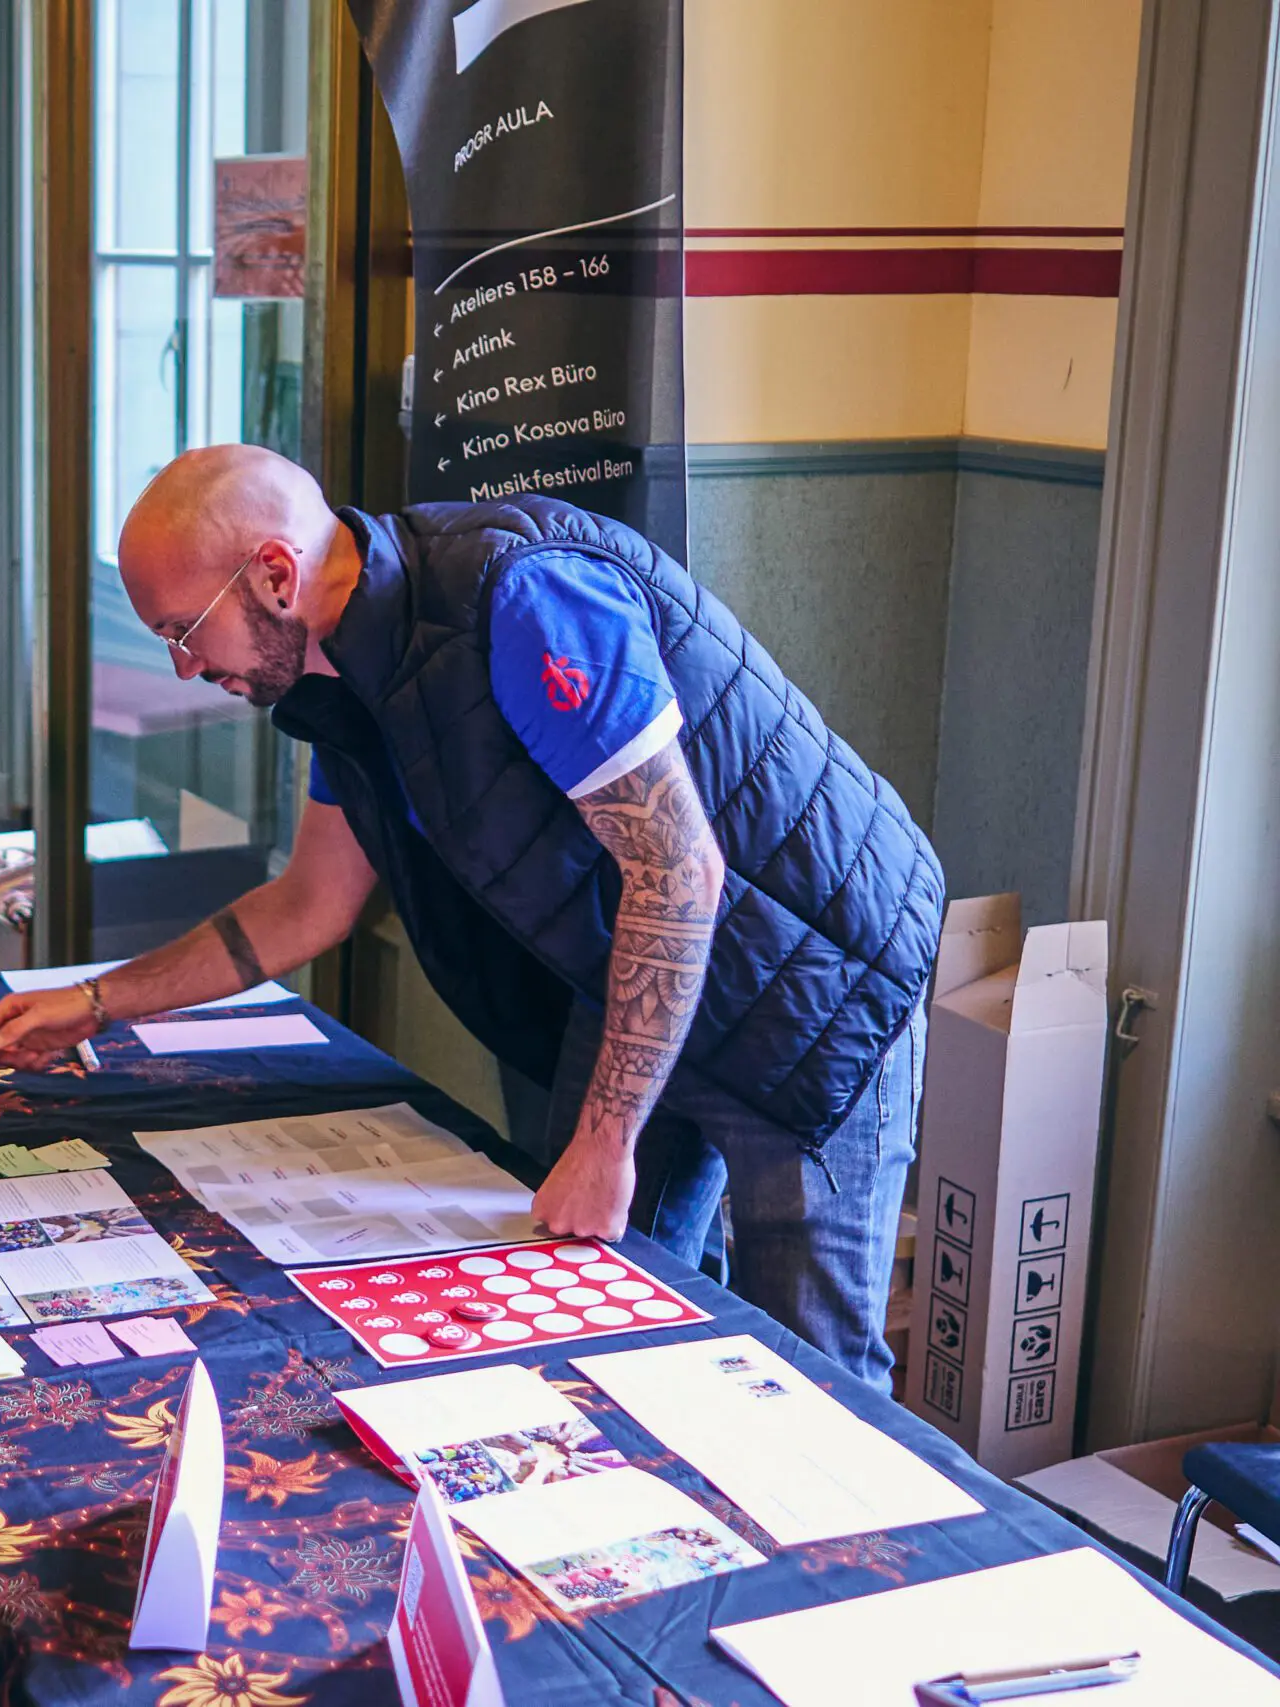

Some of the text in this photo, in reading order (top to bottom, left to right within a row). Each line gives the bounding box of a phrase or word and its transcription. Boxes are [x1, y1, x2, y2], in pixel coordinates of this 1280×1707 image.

[454, 100, 554, 173] PROGR AULA
[450, 280, 516, 323] Ateliers
[519, 265, 557, 291] 158
[579, 254, 610, 278] 166
[452, 328, 516, 370] Artlink
[456, 364, 597, 414] Kino Rex Büro
[462, 409, 626, 460] Kino Kosova Büro
[470, 459, 633, 503] Musikfestival Bern
[1034, 1380, 1046, 1419] care
